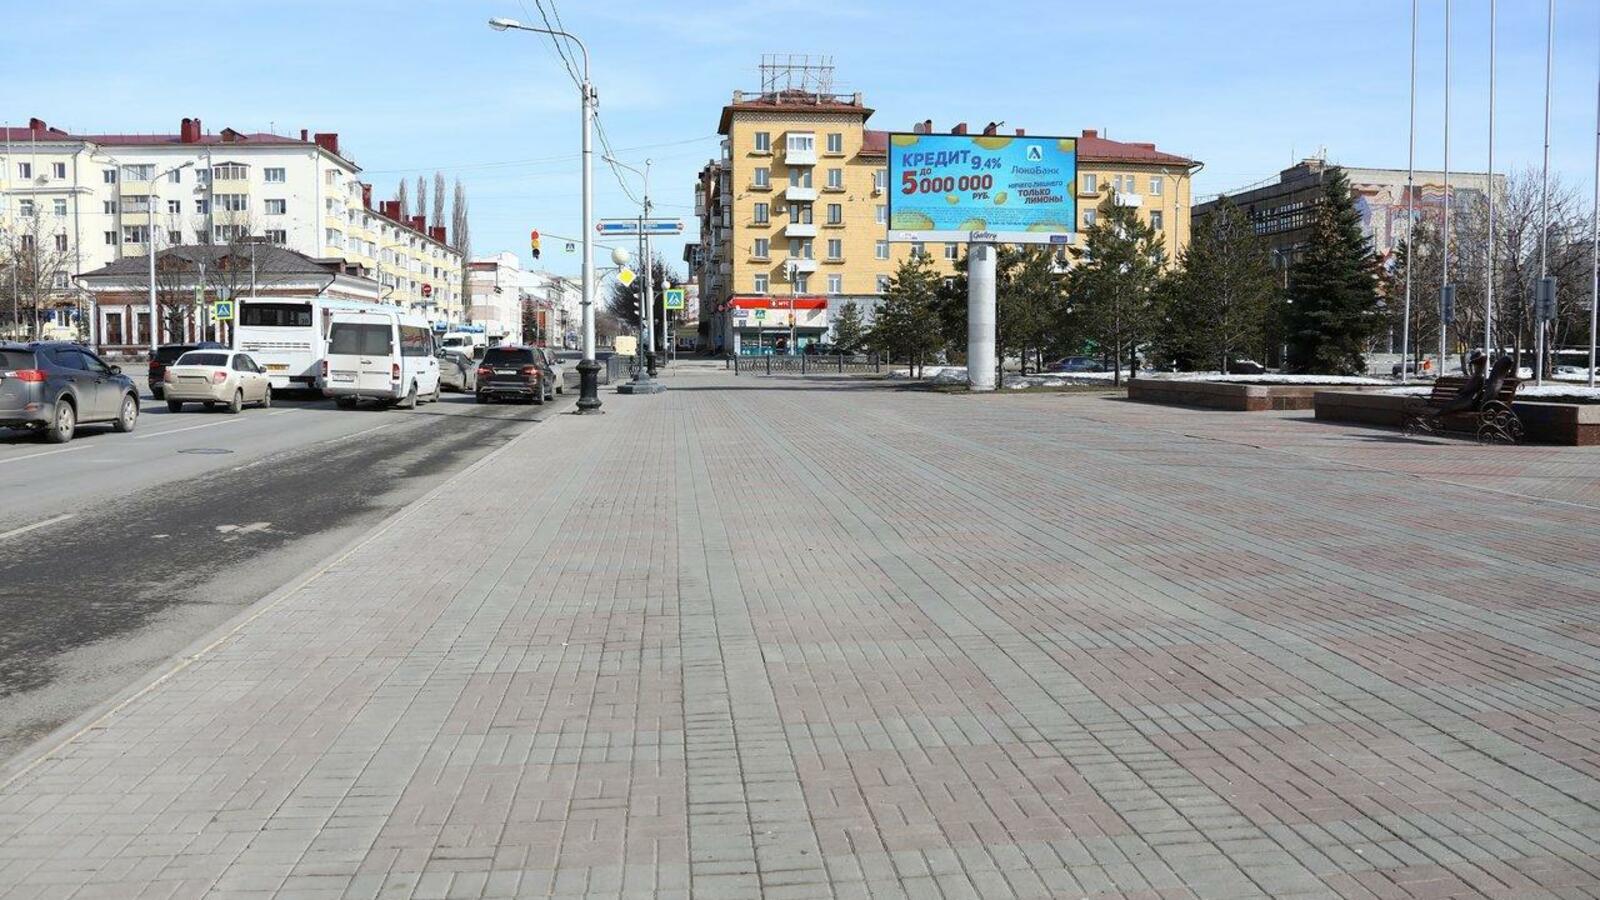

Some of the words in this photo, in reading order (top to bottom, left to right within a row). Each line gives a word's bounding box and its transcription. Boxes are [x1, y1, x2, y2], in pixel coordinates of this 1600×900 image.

[902, 150, 971, 168] КРЕДИТ
[971, 156, 1002, 171] 9,4%
[919, 168, 932, 176] ДО
[901, 170, 917, 195] 5
[919, 176, 955, 194] 000
[958, 174, 993, 192] 000
[1017, 188, 1051, 197] ТОЛЬКО
